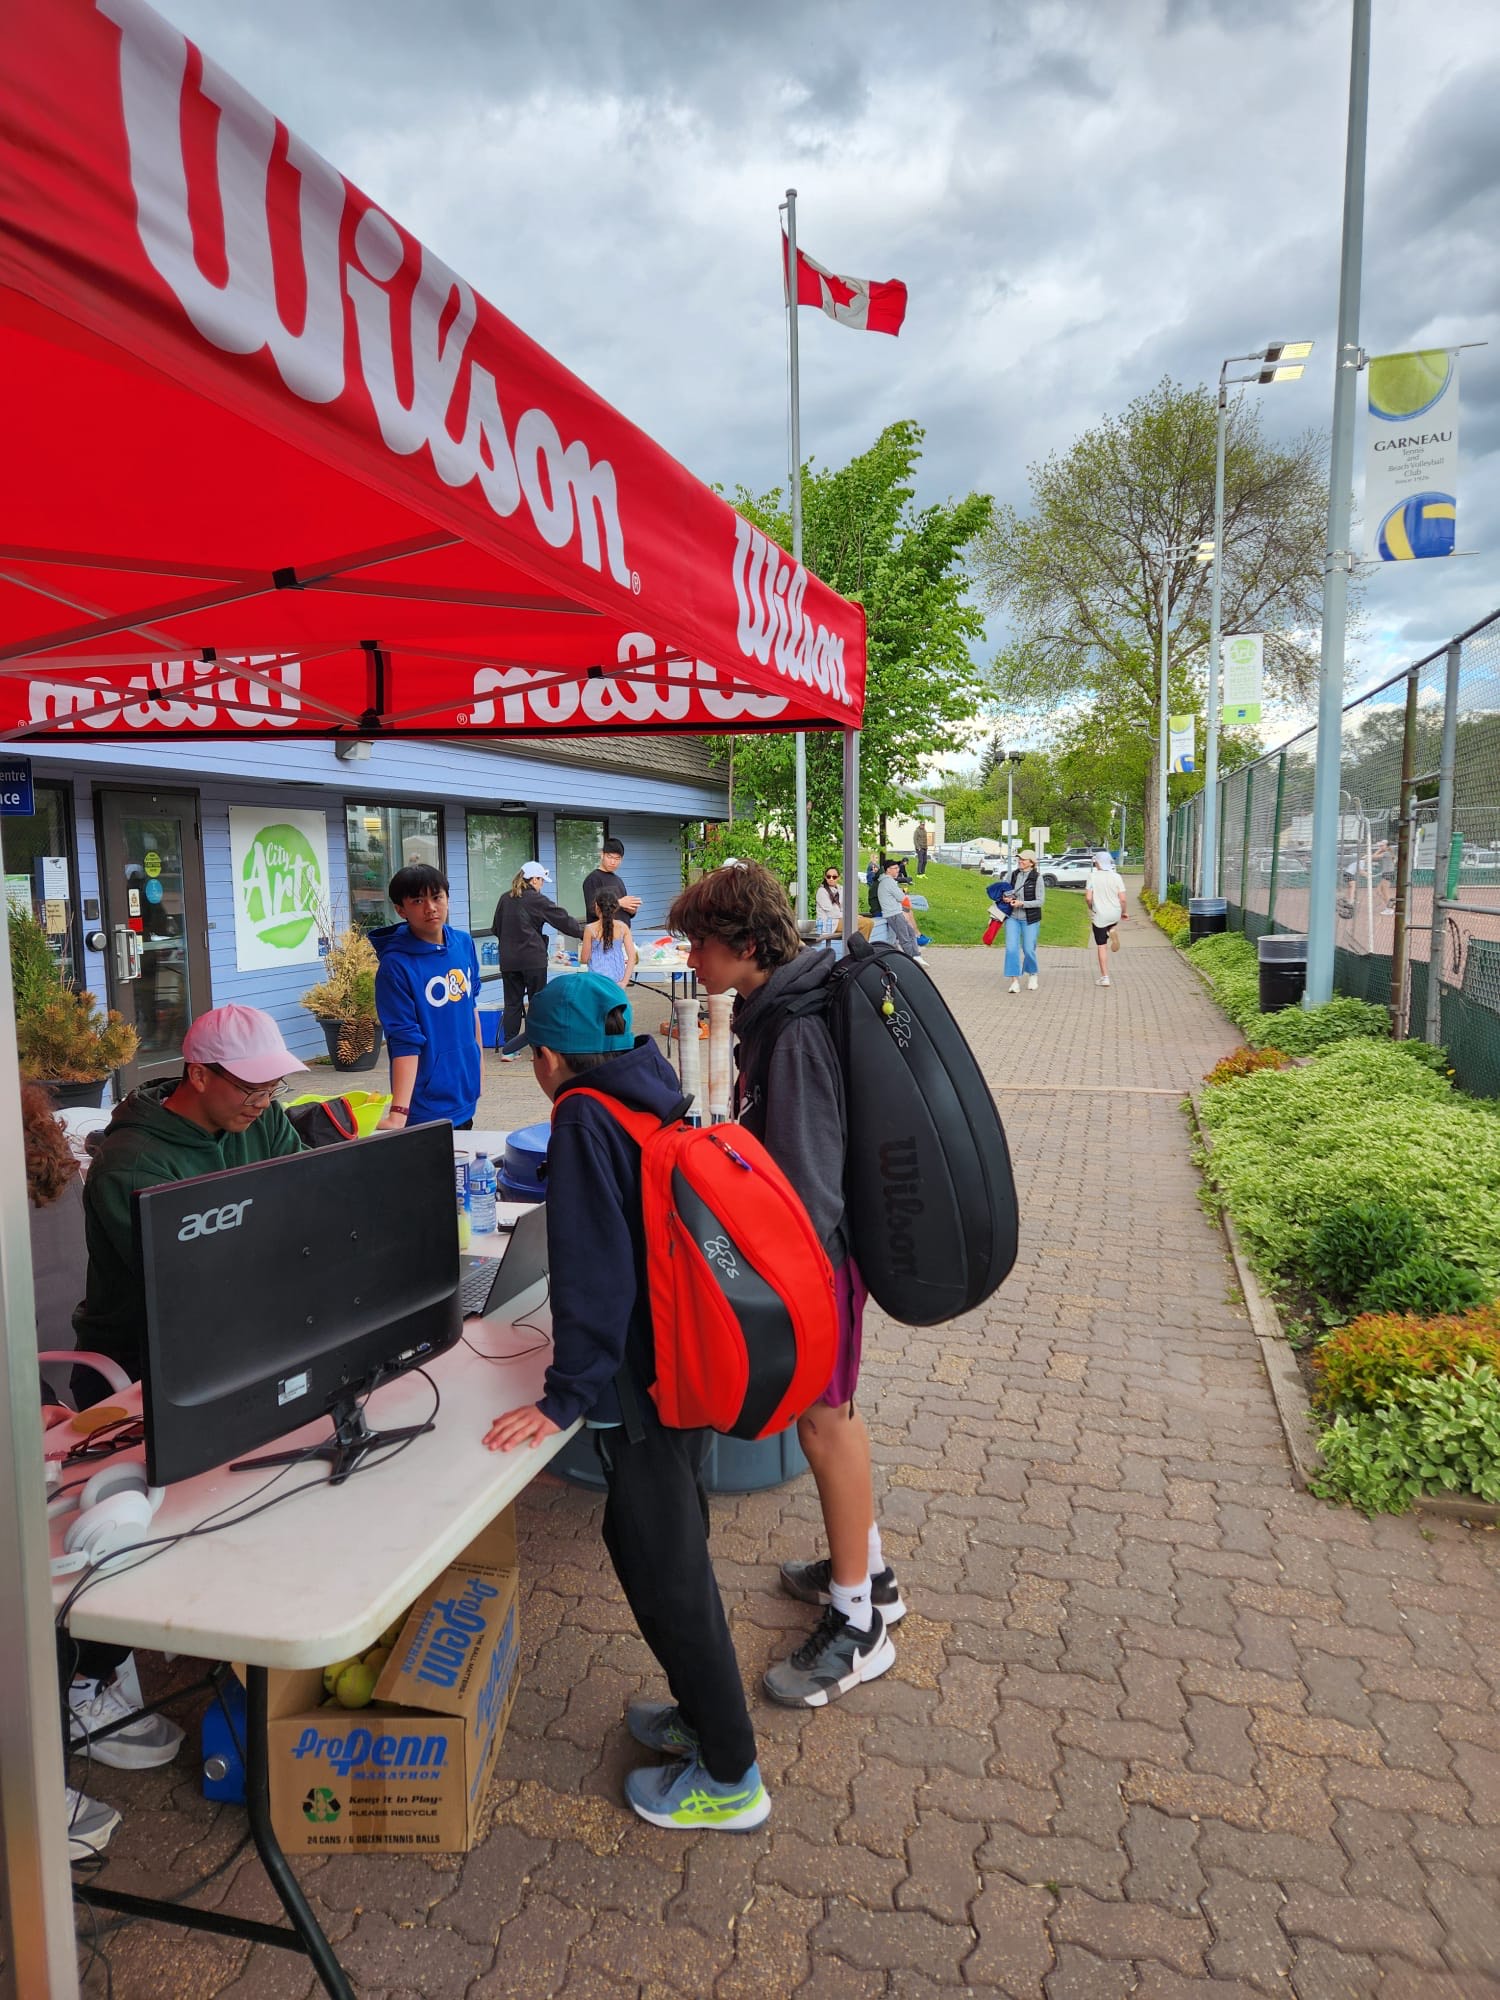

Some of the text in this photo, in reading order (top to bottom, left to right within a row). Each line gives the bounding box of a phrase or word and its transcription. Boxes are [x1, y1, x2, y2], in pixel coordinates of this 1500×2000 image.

[96, 0, 634, 591] Wilson
[1374, 431, 1452, 452] GARNEAU
[732, 513, 852, 706] Wilson
[241, 841, 321, 919] Arts
[265, 841, 293, 872] City
[178, 1198, 253, 1242] acer
[879, 1135, 925, 1277] Wilson
[402, 1609, 436, 1674] MARATHON
[416, 1577, 499, 1688] ProPenn
[291, 1727, 448, 1777] ProPenn
[351, 1771, 441, 1781] MARATHON
[348, 1809, 438, 1817] PLEASE RECYCLE
[349, 1795, 380, 1805] Keep
[307, 1836, 318, 1845] 24
[319, 1835, 341, 1845] CANS
[356, 1835, 382, 1844] DOZEN
[384, 1835, 414, 1844] TENNIS
[415, 1834, 441, 1844] BALLS
